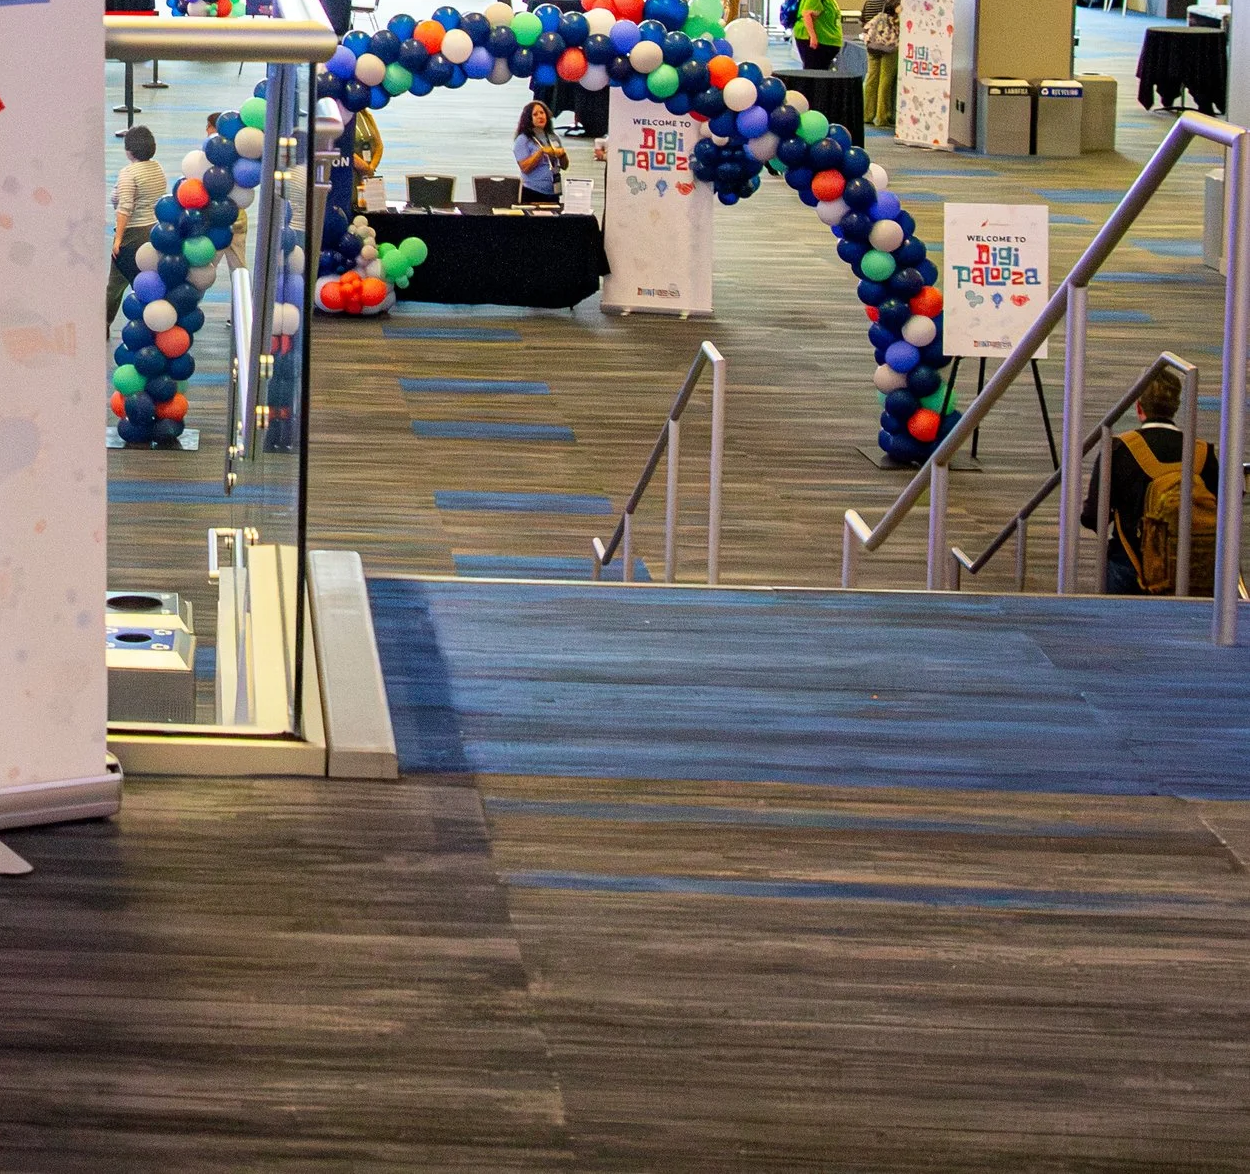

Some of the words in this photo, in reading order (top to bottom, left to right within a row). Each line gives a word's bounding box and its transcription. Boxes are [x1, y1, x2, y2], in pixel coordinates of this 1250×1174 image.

[632, 118, 676, 128] WELCOME
[679, 120, 692, 129] TO
[639, 127, 684, 152] Digi
[966, 234, 1012, 243] WELCOME
[1015, 236, 1026, 244] TO
[974, 244, 1020, 267] Digi
